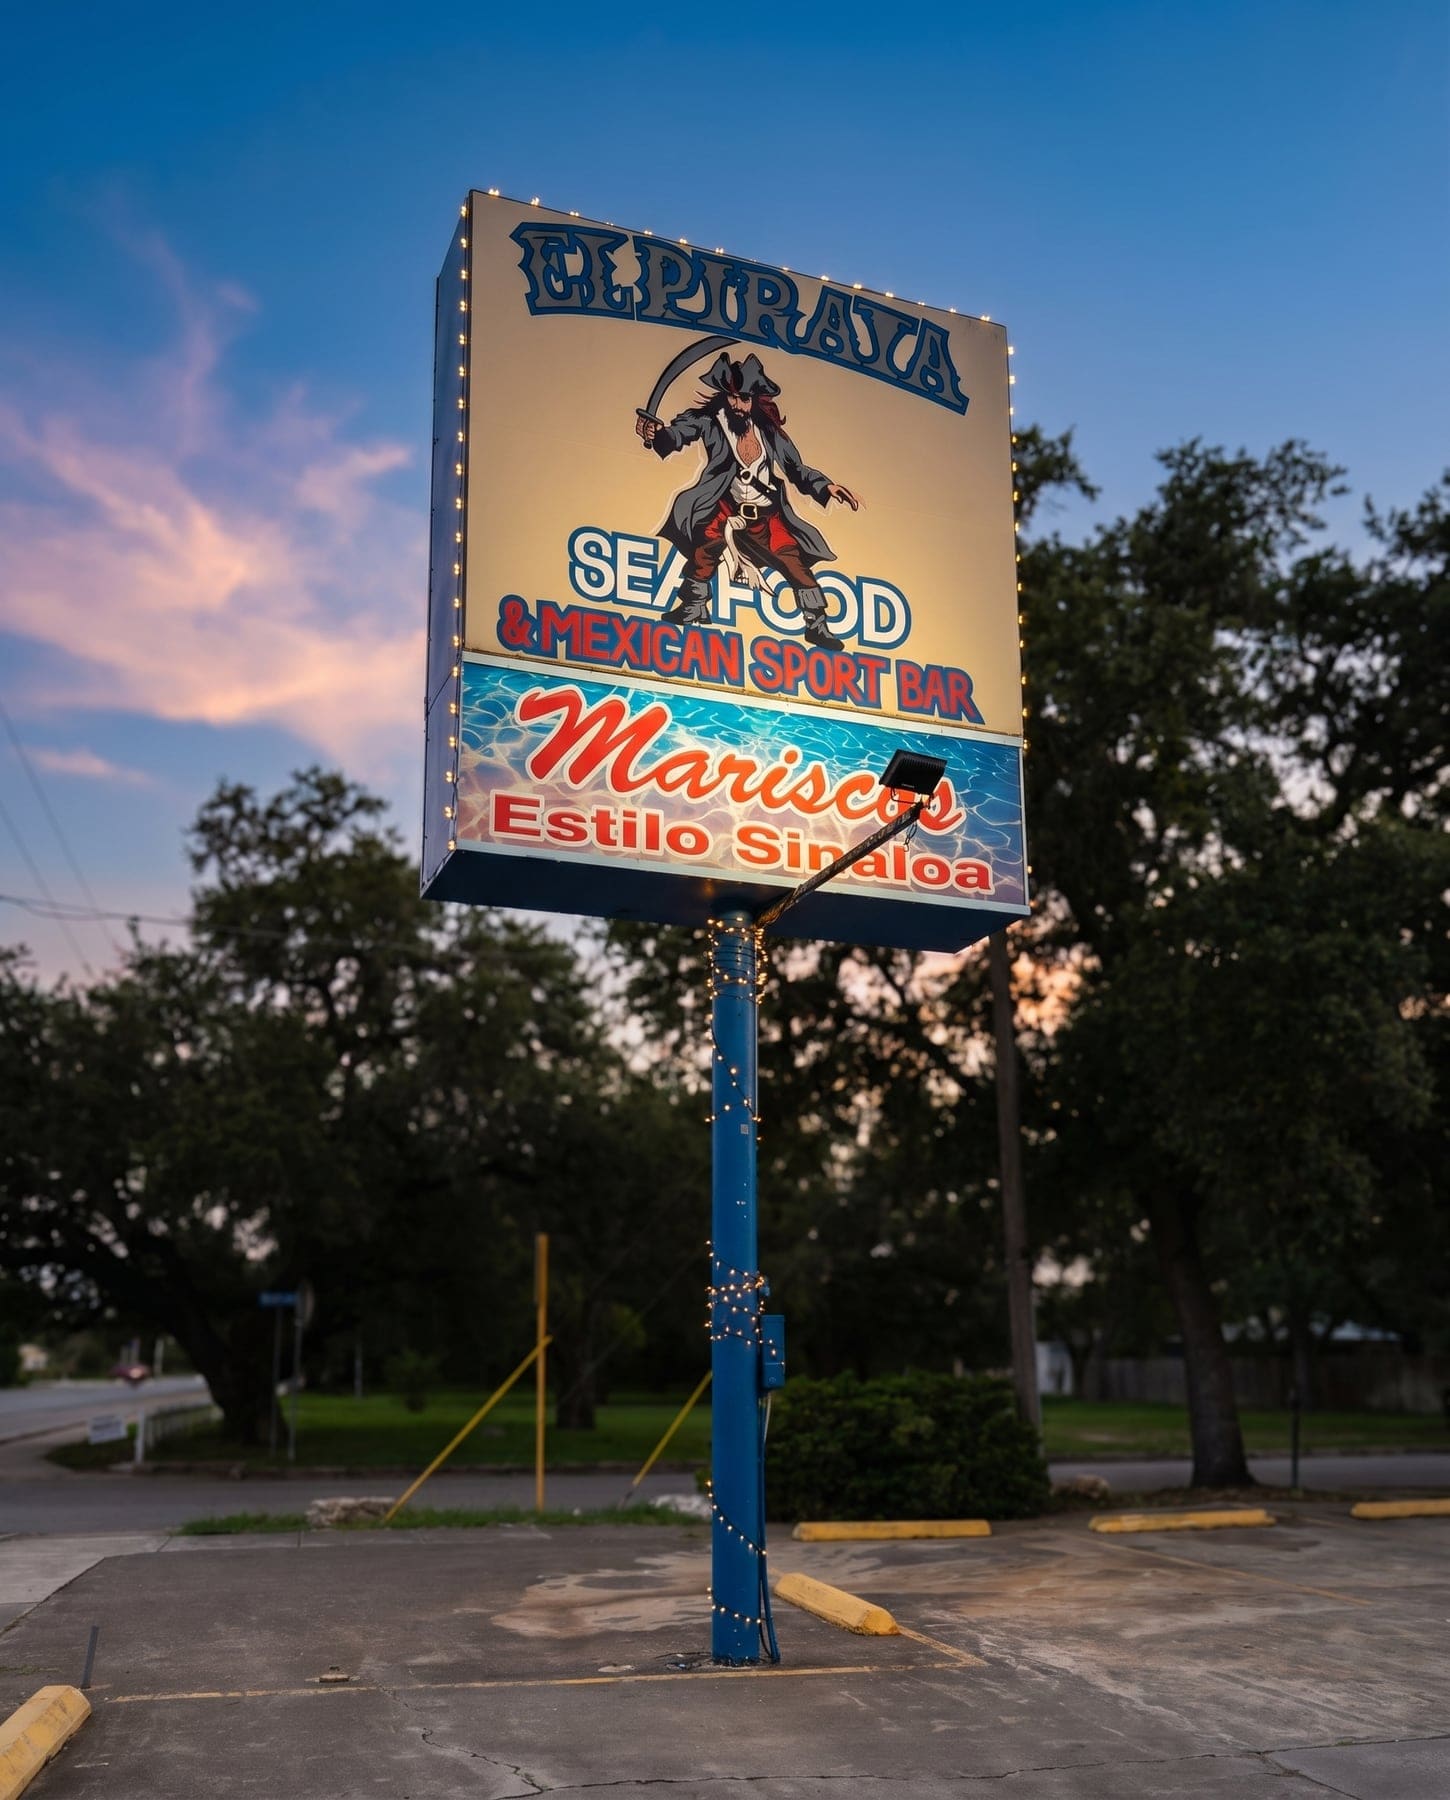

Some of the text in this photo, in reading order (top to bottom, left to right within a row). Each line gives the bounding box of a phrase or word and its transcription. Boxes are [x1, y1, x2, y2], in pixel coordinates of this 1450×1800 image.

[509, 222, 970, 416] EL PIRATA
[497, 594, 985, 725] & MEXICAN SPORT BAR
[516, 685, 965, 835] Mariscos
[491, 789, 995, 894] Estilo Sinaloa
